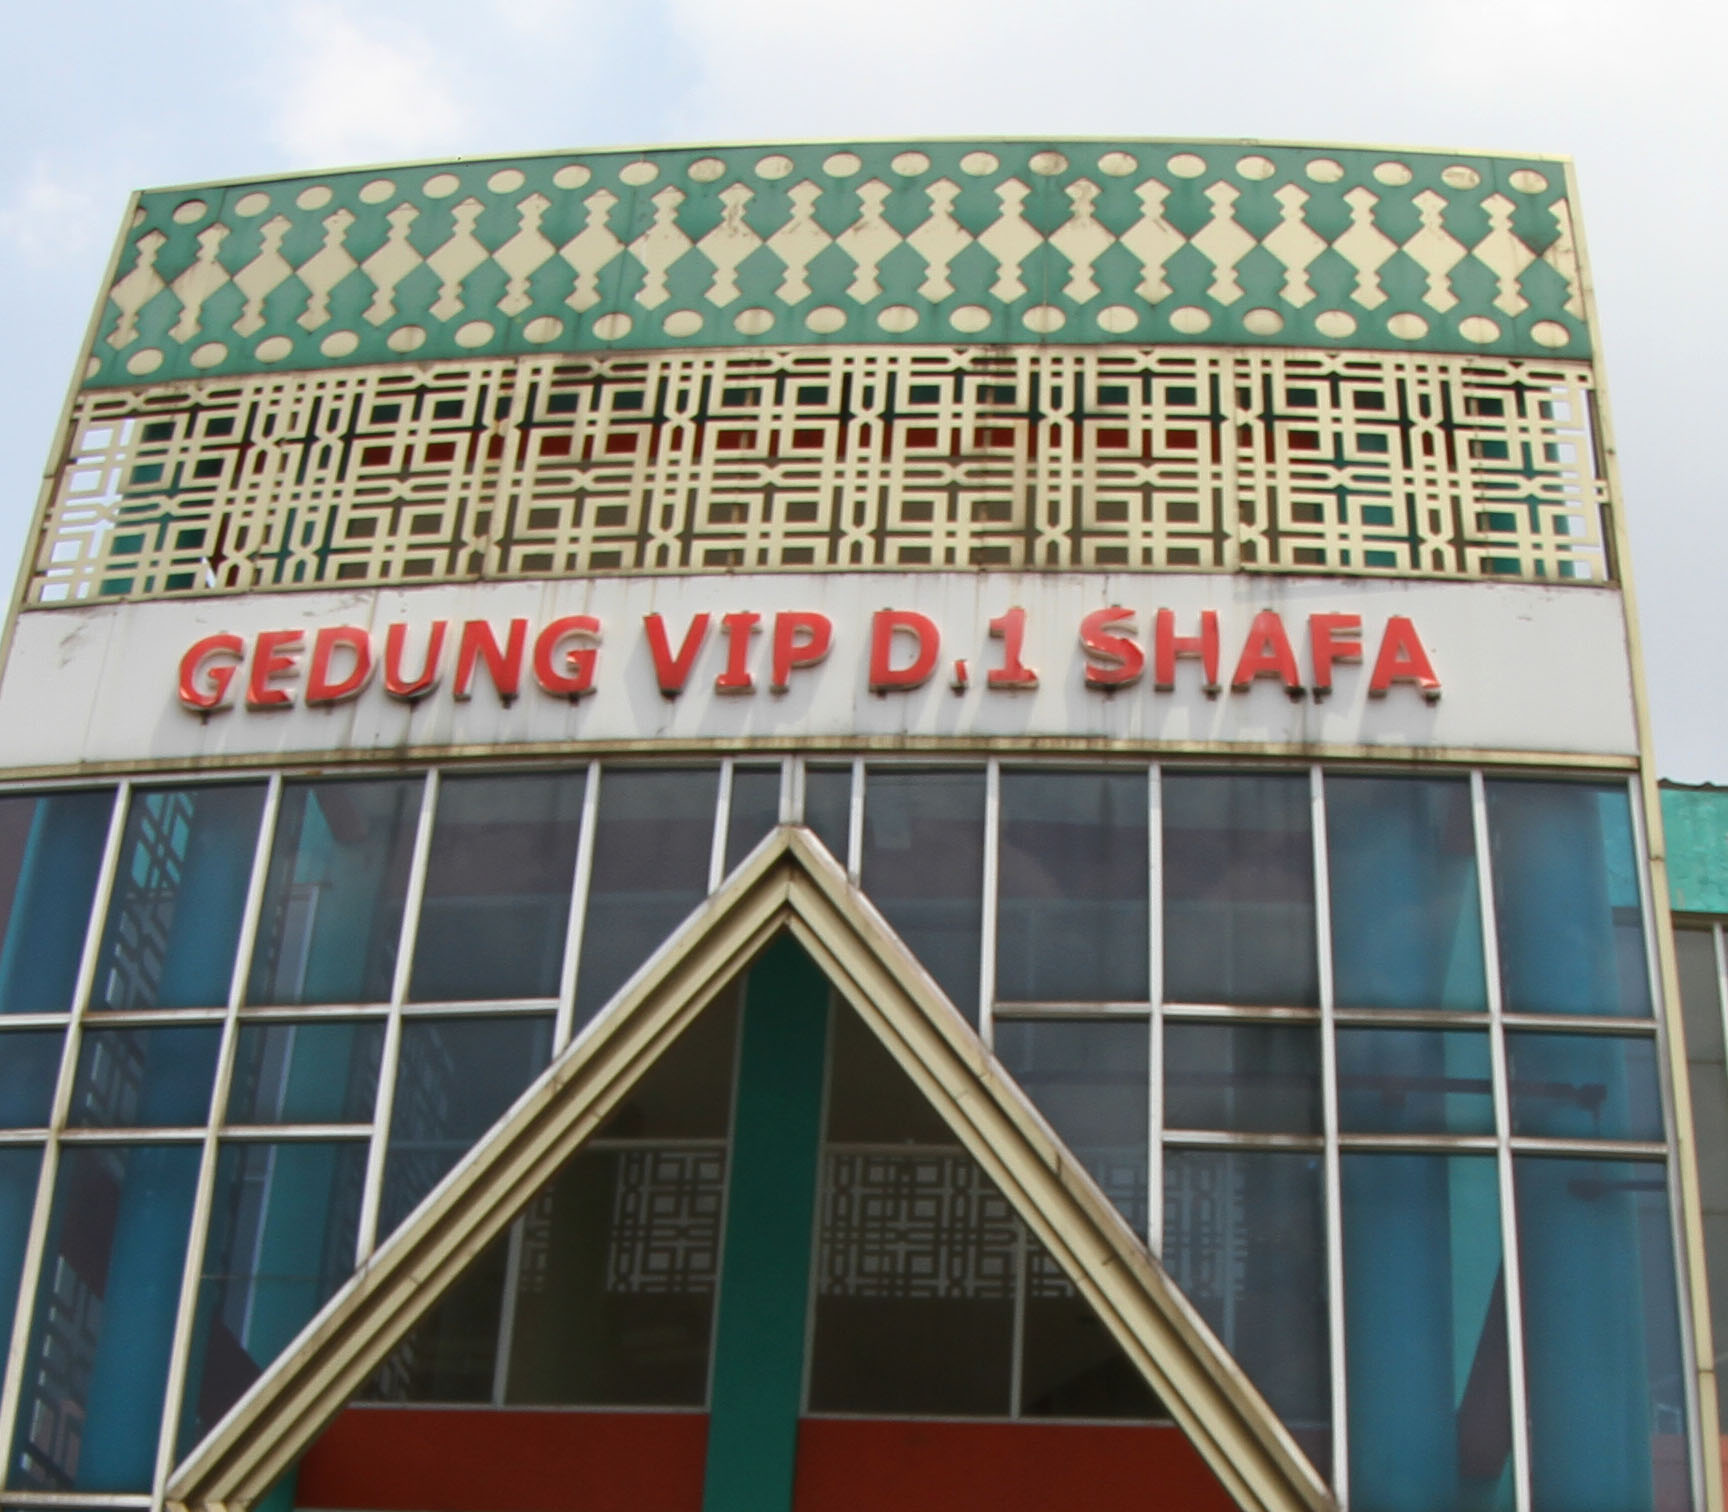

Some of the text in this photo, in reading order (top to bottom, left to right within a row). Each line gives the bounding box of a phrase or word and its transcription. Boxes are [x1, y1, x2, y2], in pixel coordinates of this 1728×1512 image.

[178, 605, 1442, 711] GEDUNG VIP D.1 SHAFA
